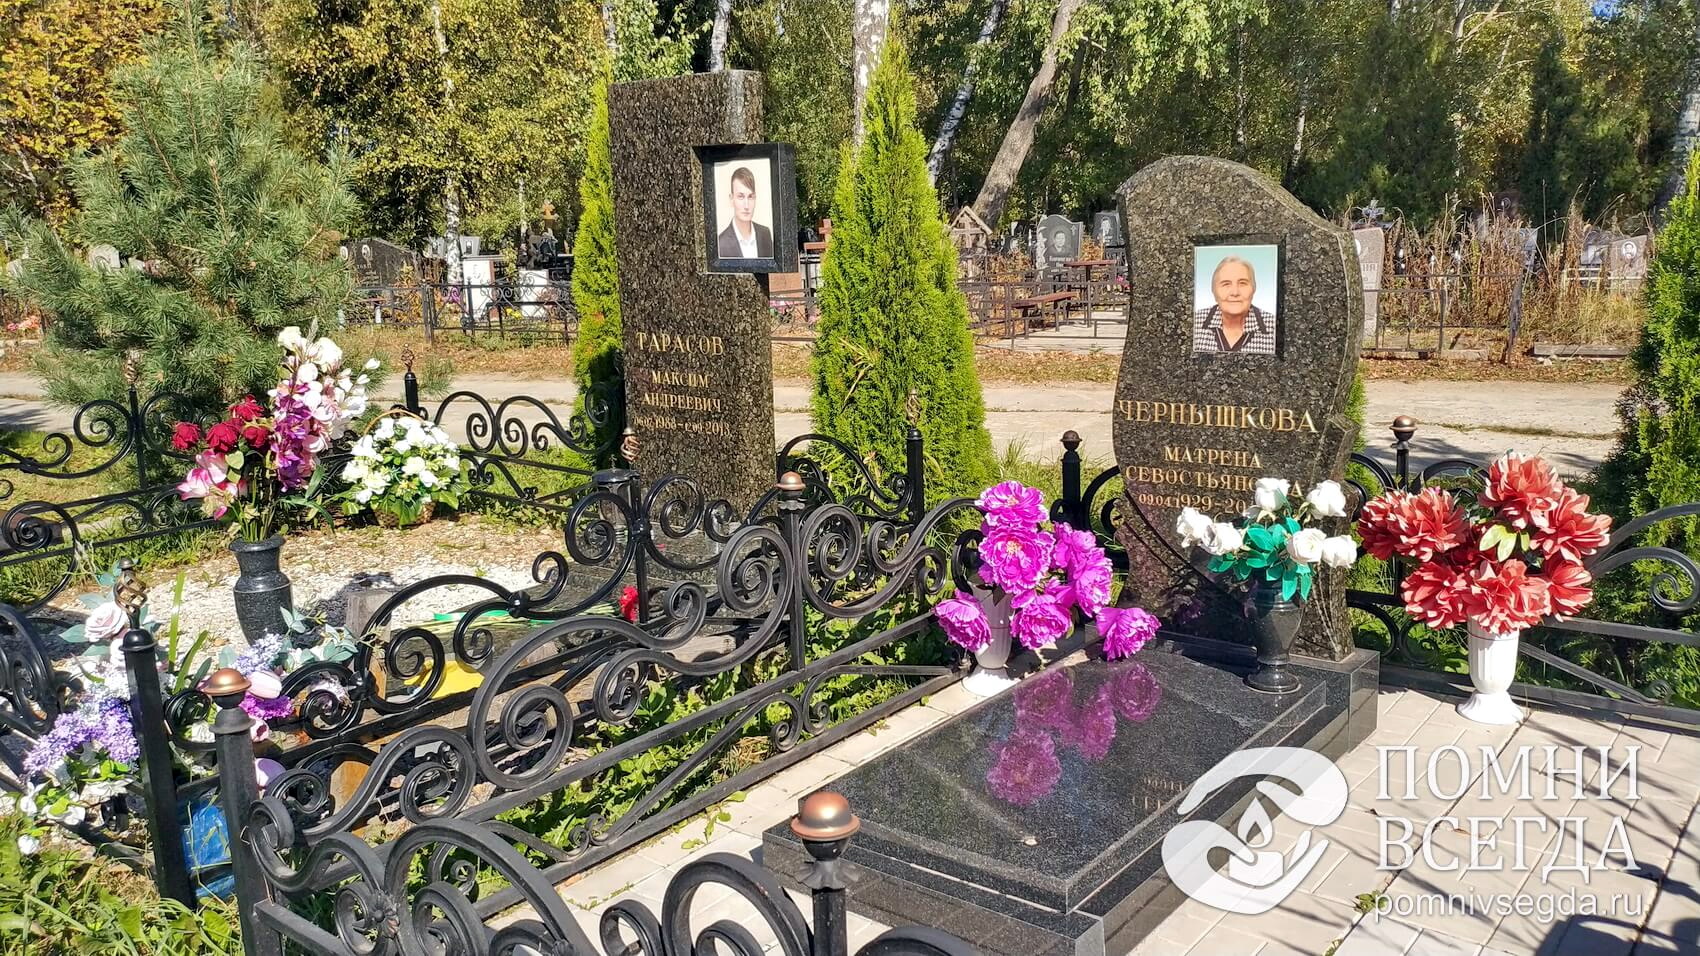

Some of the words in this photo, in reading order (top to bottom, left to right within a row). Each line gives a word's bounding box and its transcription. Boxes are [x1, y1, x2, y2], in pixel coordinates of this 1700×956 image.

[636, 332, 724, 356] ТАРАСОВ
[652, 370, 709, 388] МАКСИМ
[642, 392, 721, 412] АНДРЕЕВИЧ
[1118, 400, 1318, 433] ЧЕРНЫШКОВА
[1164, 446, 1263, 469] МАТРЕНА
